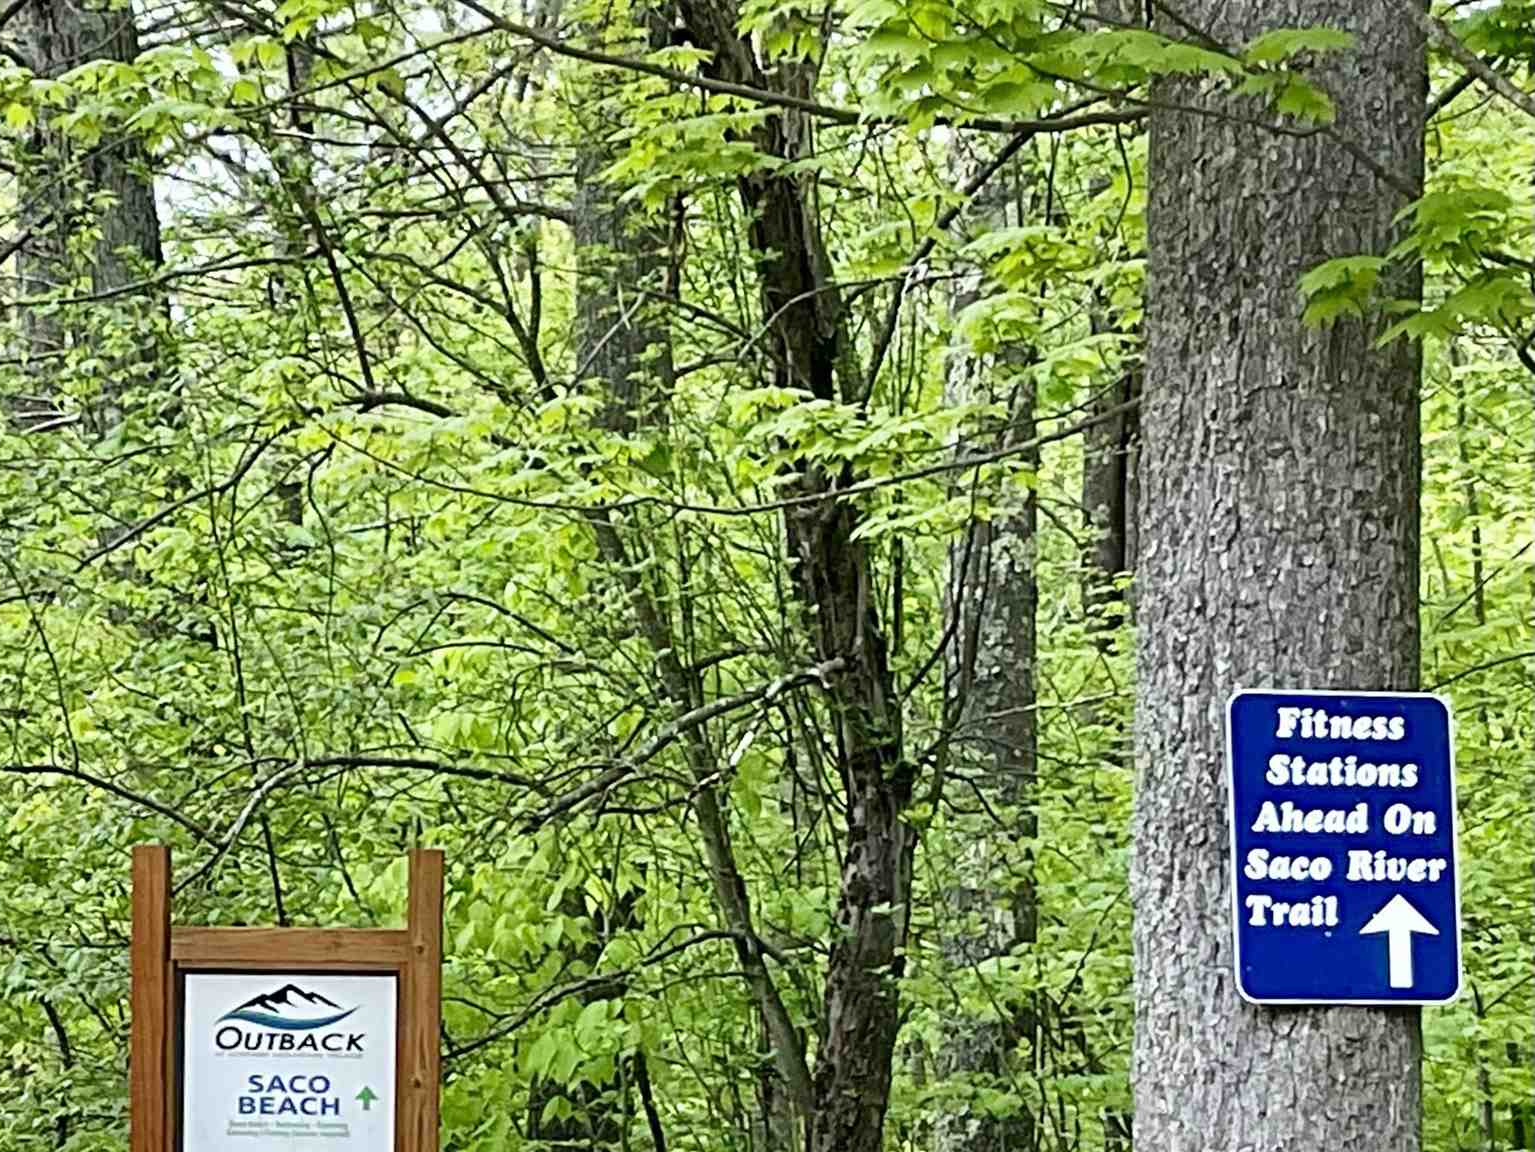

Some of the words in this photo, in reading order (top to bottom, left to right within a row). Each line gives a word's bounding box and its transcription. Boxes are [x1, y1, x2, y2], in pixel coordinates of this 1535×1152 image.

[1276, 706, 1405, 740] Fitness
[1265, 753, 1418, 787] Stations
[1252, 801, 1369, 834] Ahead
[1384, 803, 1437, 835] On
[1244, 848, 1332, 881] Saco
[1346, 850, 1446, 882] River
[1246, 894, 1338, 927] Trail
[248, 1074, 331, 1094] SACO
[238, 1096, 340, 1116] BEACH
